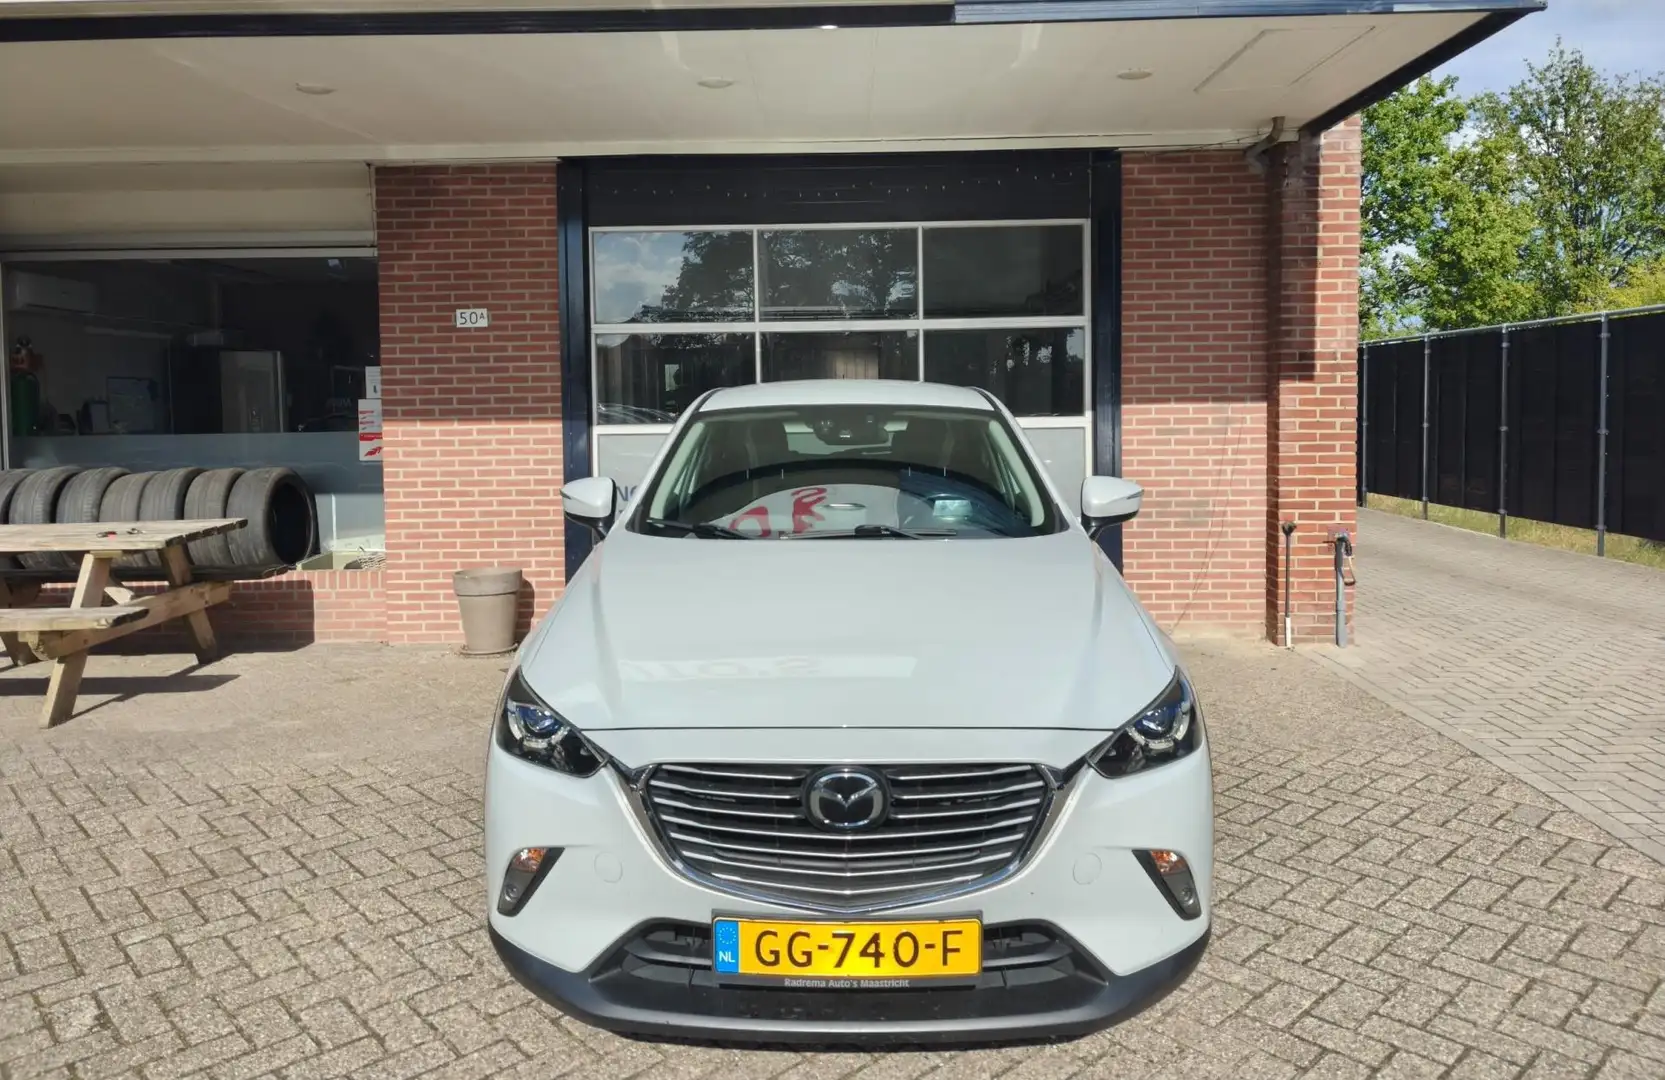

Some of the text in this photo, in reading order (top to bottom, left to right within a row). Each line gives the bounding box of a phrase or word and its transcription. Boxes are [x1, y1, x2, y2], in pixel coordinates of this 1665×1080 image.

[718, 929, 964, 969] NL GG-740-F
[828, 979, 859, 988] Auto's
[860, 979, 909, 988] Maastricht
